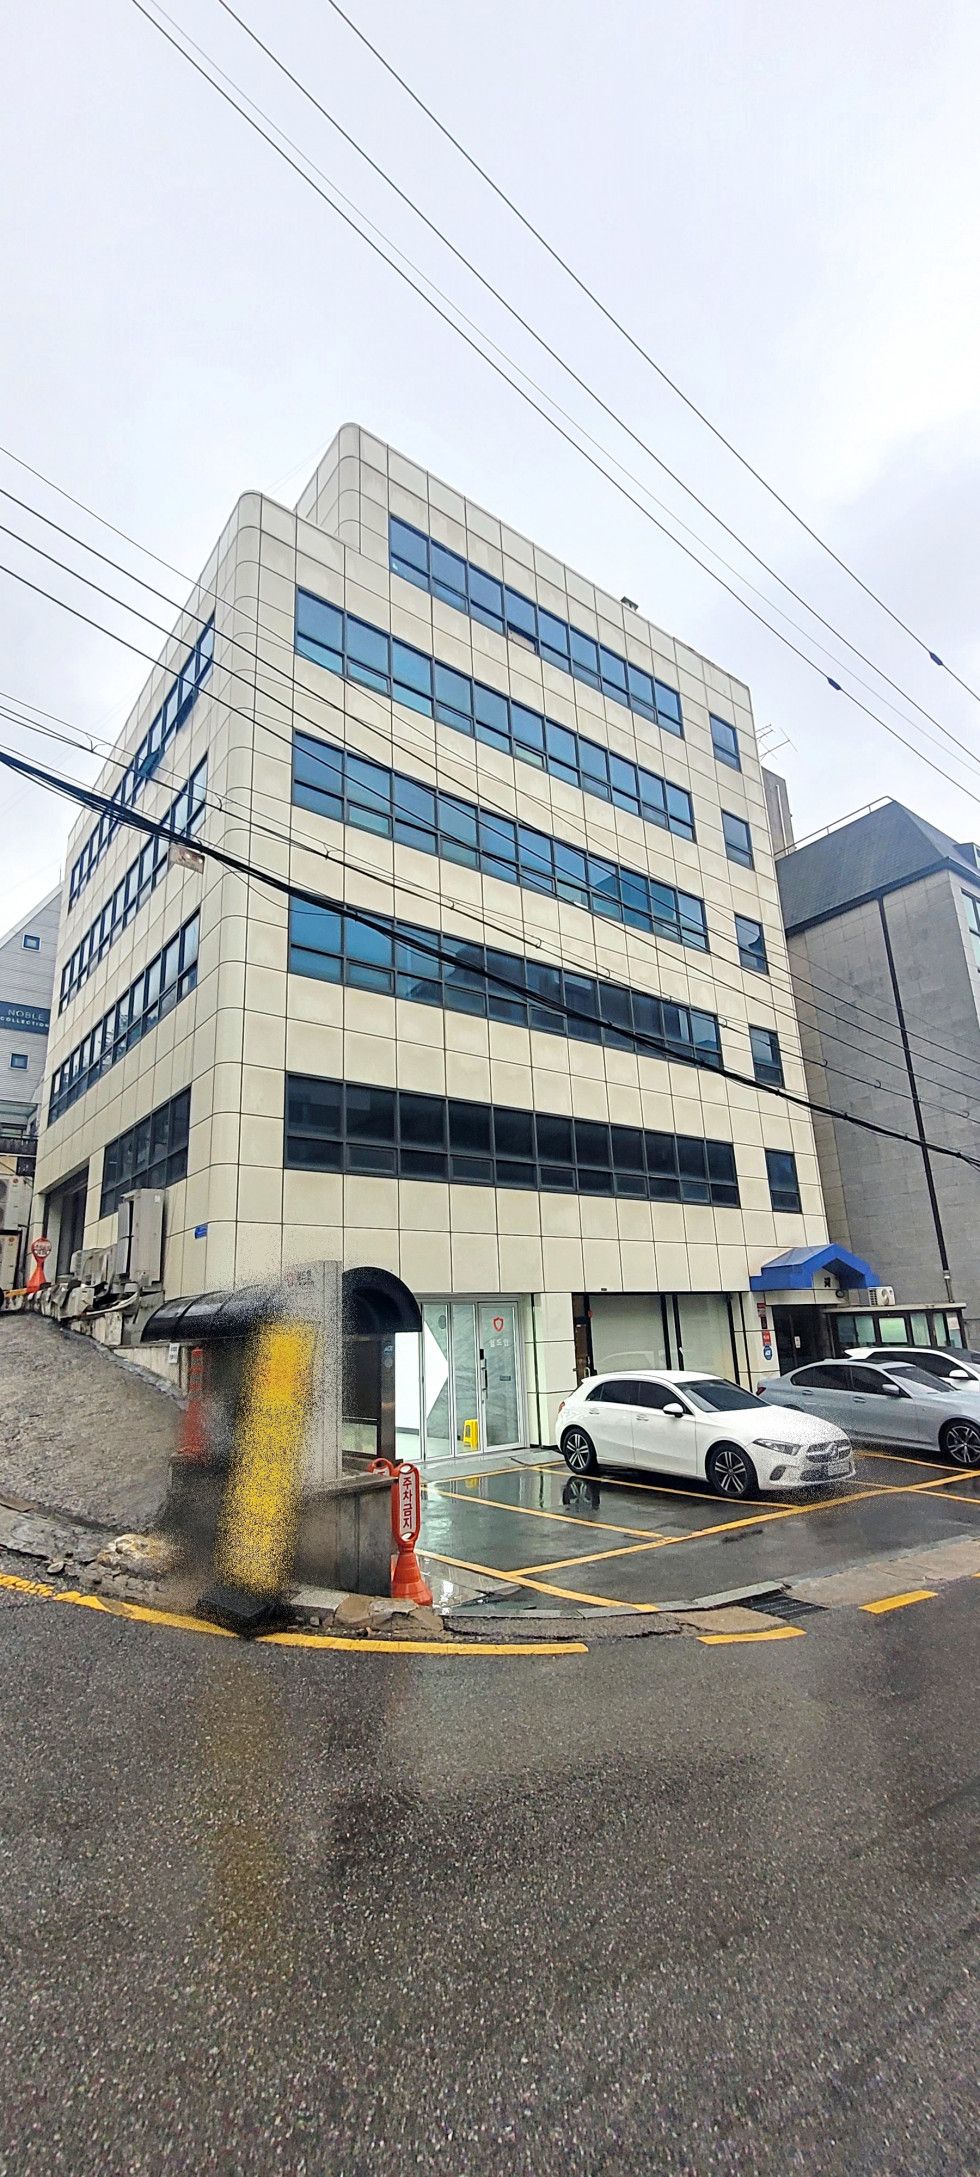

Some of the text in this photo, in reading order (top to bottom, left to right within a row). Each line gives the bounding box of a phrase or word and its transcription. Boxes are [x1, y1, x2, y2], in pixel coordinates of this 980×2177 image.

[8, 1009, 44, 1021] NOBLE
[0, 1016, 49, 1027] COLLECTION
[403, 1477, 412, 1530] 주차금지
